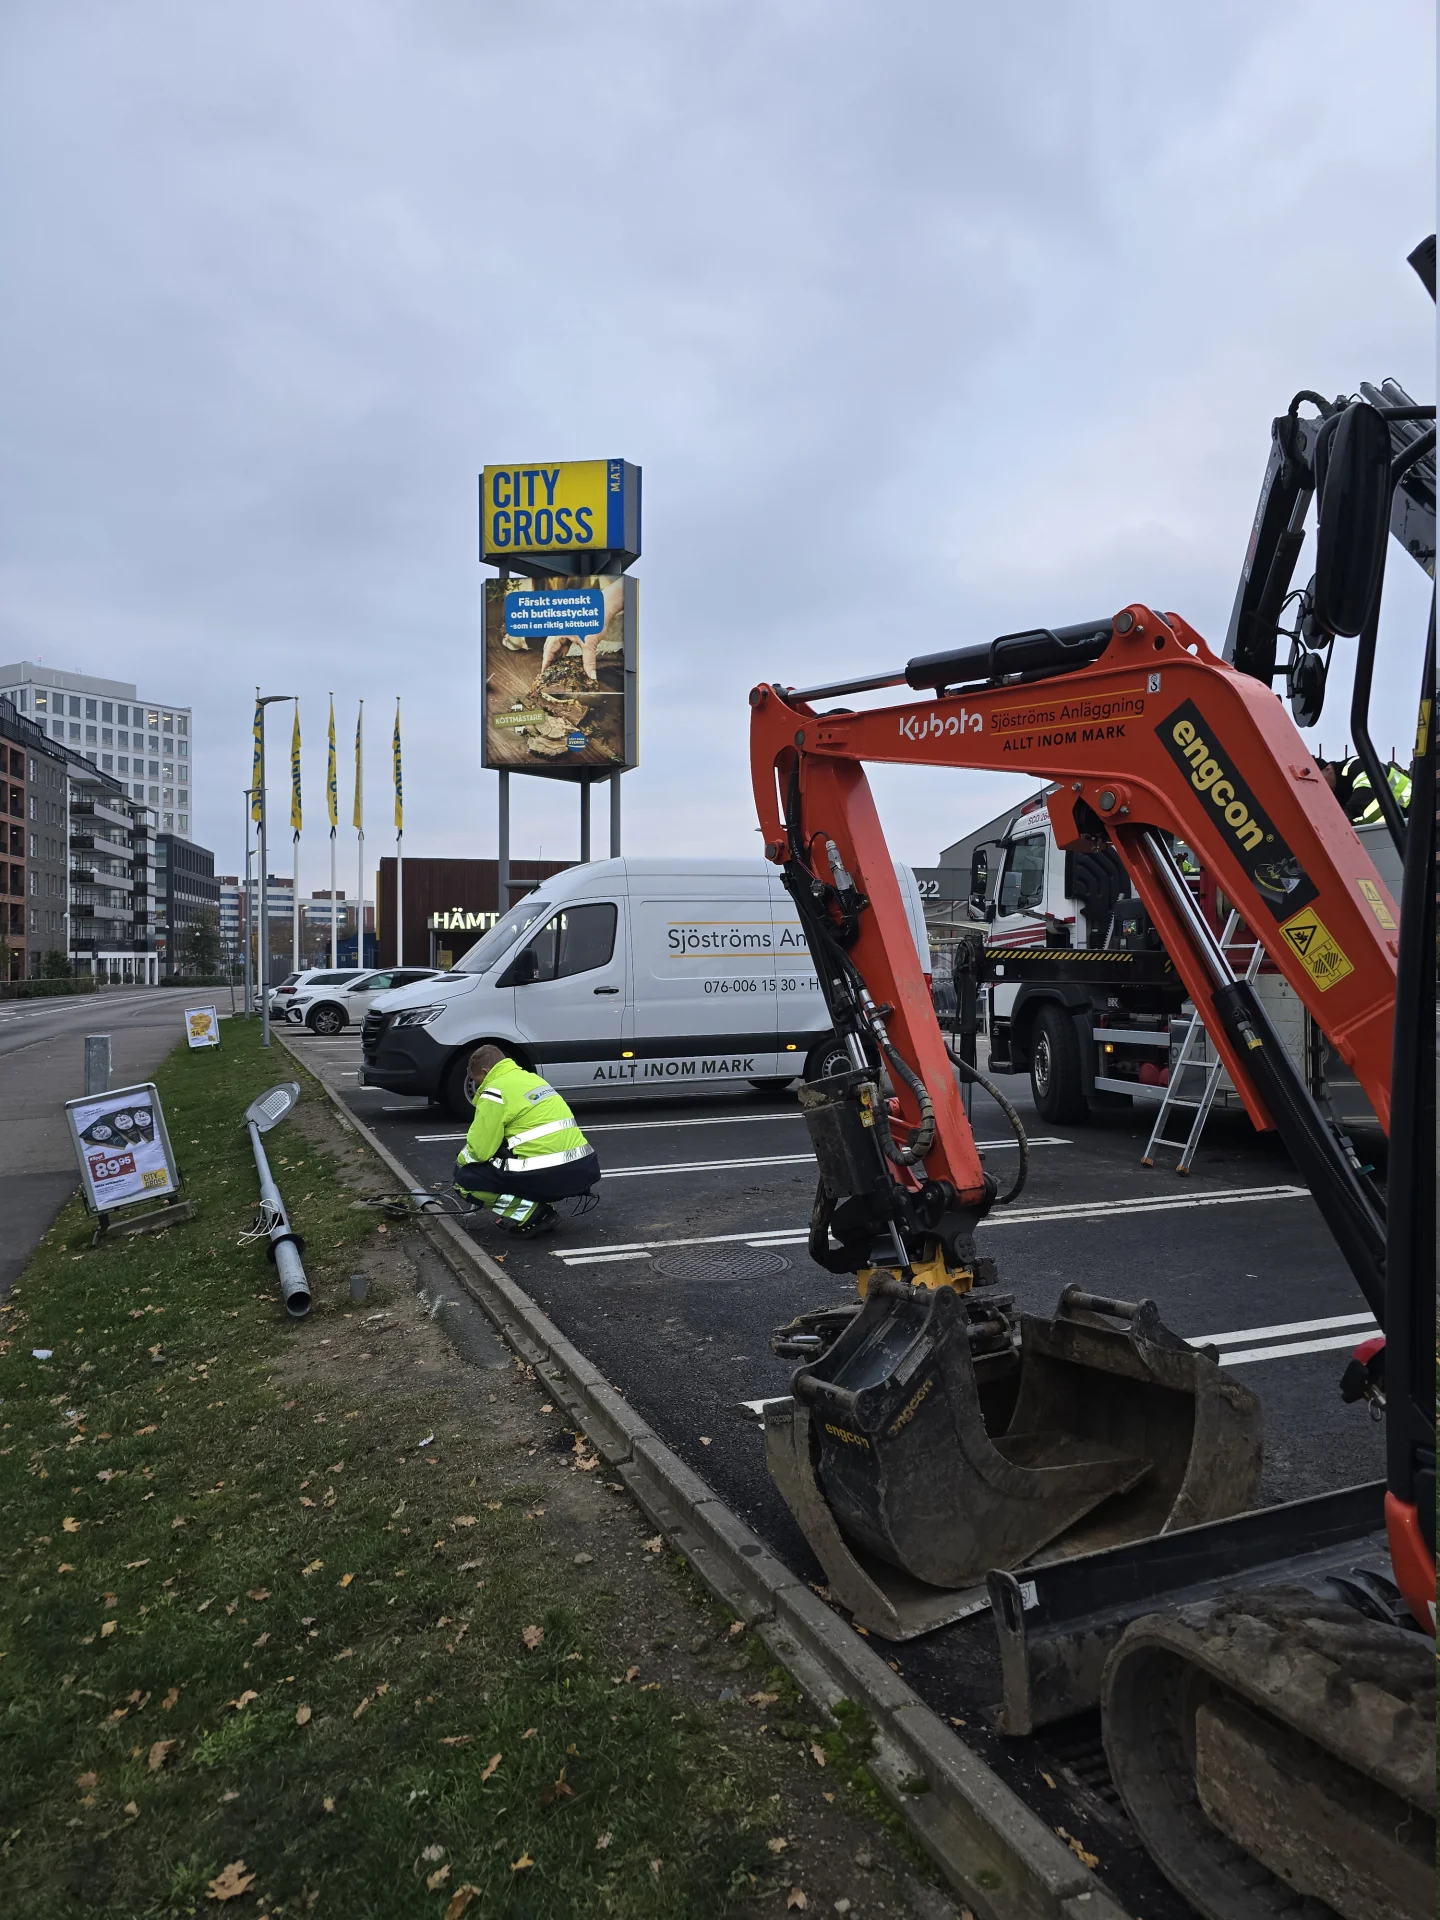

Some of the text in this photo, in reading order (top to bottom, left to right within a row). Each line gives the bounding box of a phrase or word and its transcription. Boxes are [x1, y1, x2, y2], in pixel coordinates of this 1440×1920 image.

[493, 469, 560, 508] CITY
[493, 507, 593, 547] GROSS
[510, 607, 599, 619] och butiksstyckat
[518, 595, 591, 607] Färskt svenskt
[565, 620, 600, 628] köttbutik
[899, 708, 983, 741] Kubota
[991, 698, 1145, 733] Sjöströms Anläggning
[1003, 725, 1126, 751] ALLT INOM MARK
[1172, 720, 1264, 852] engcon
[668, 928, 772, 954] Sjöströms
[704, 979, 757, 994] 076-006
[761, 979, 777, 992] 15
[781, 979, 796, 991] 30
[593, 1058, 755, 1080] ALLT INOM MARK
[143, 1172, 158, 1182] CITY
[825, 1422, 870, 1449] engcon
